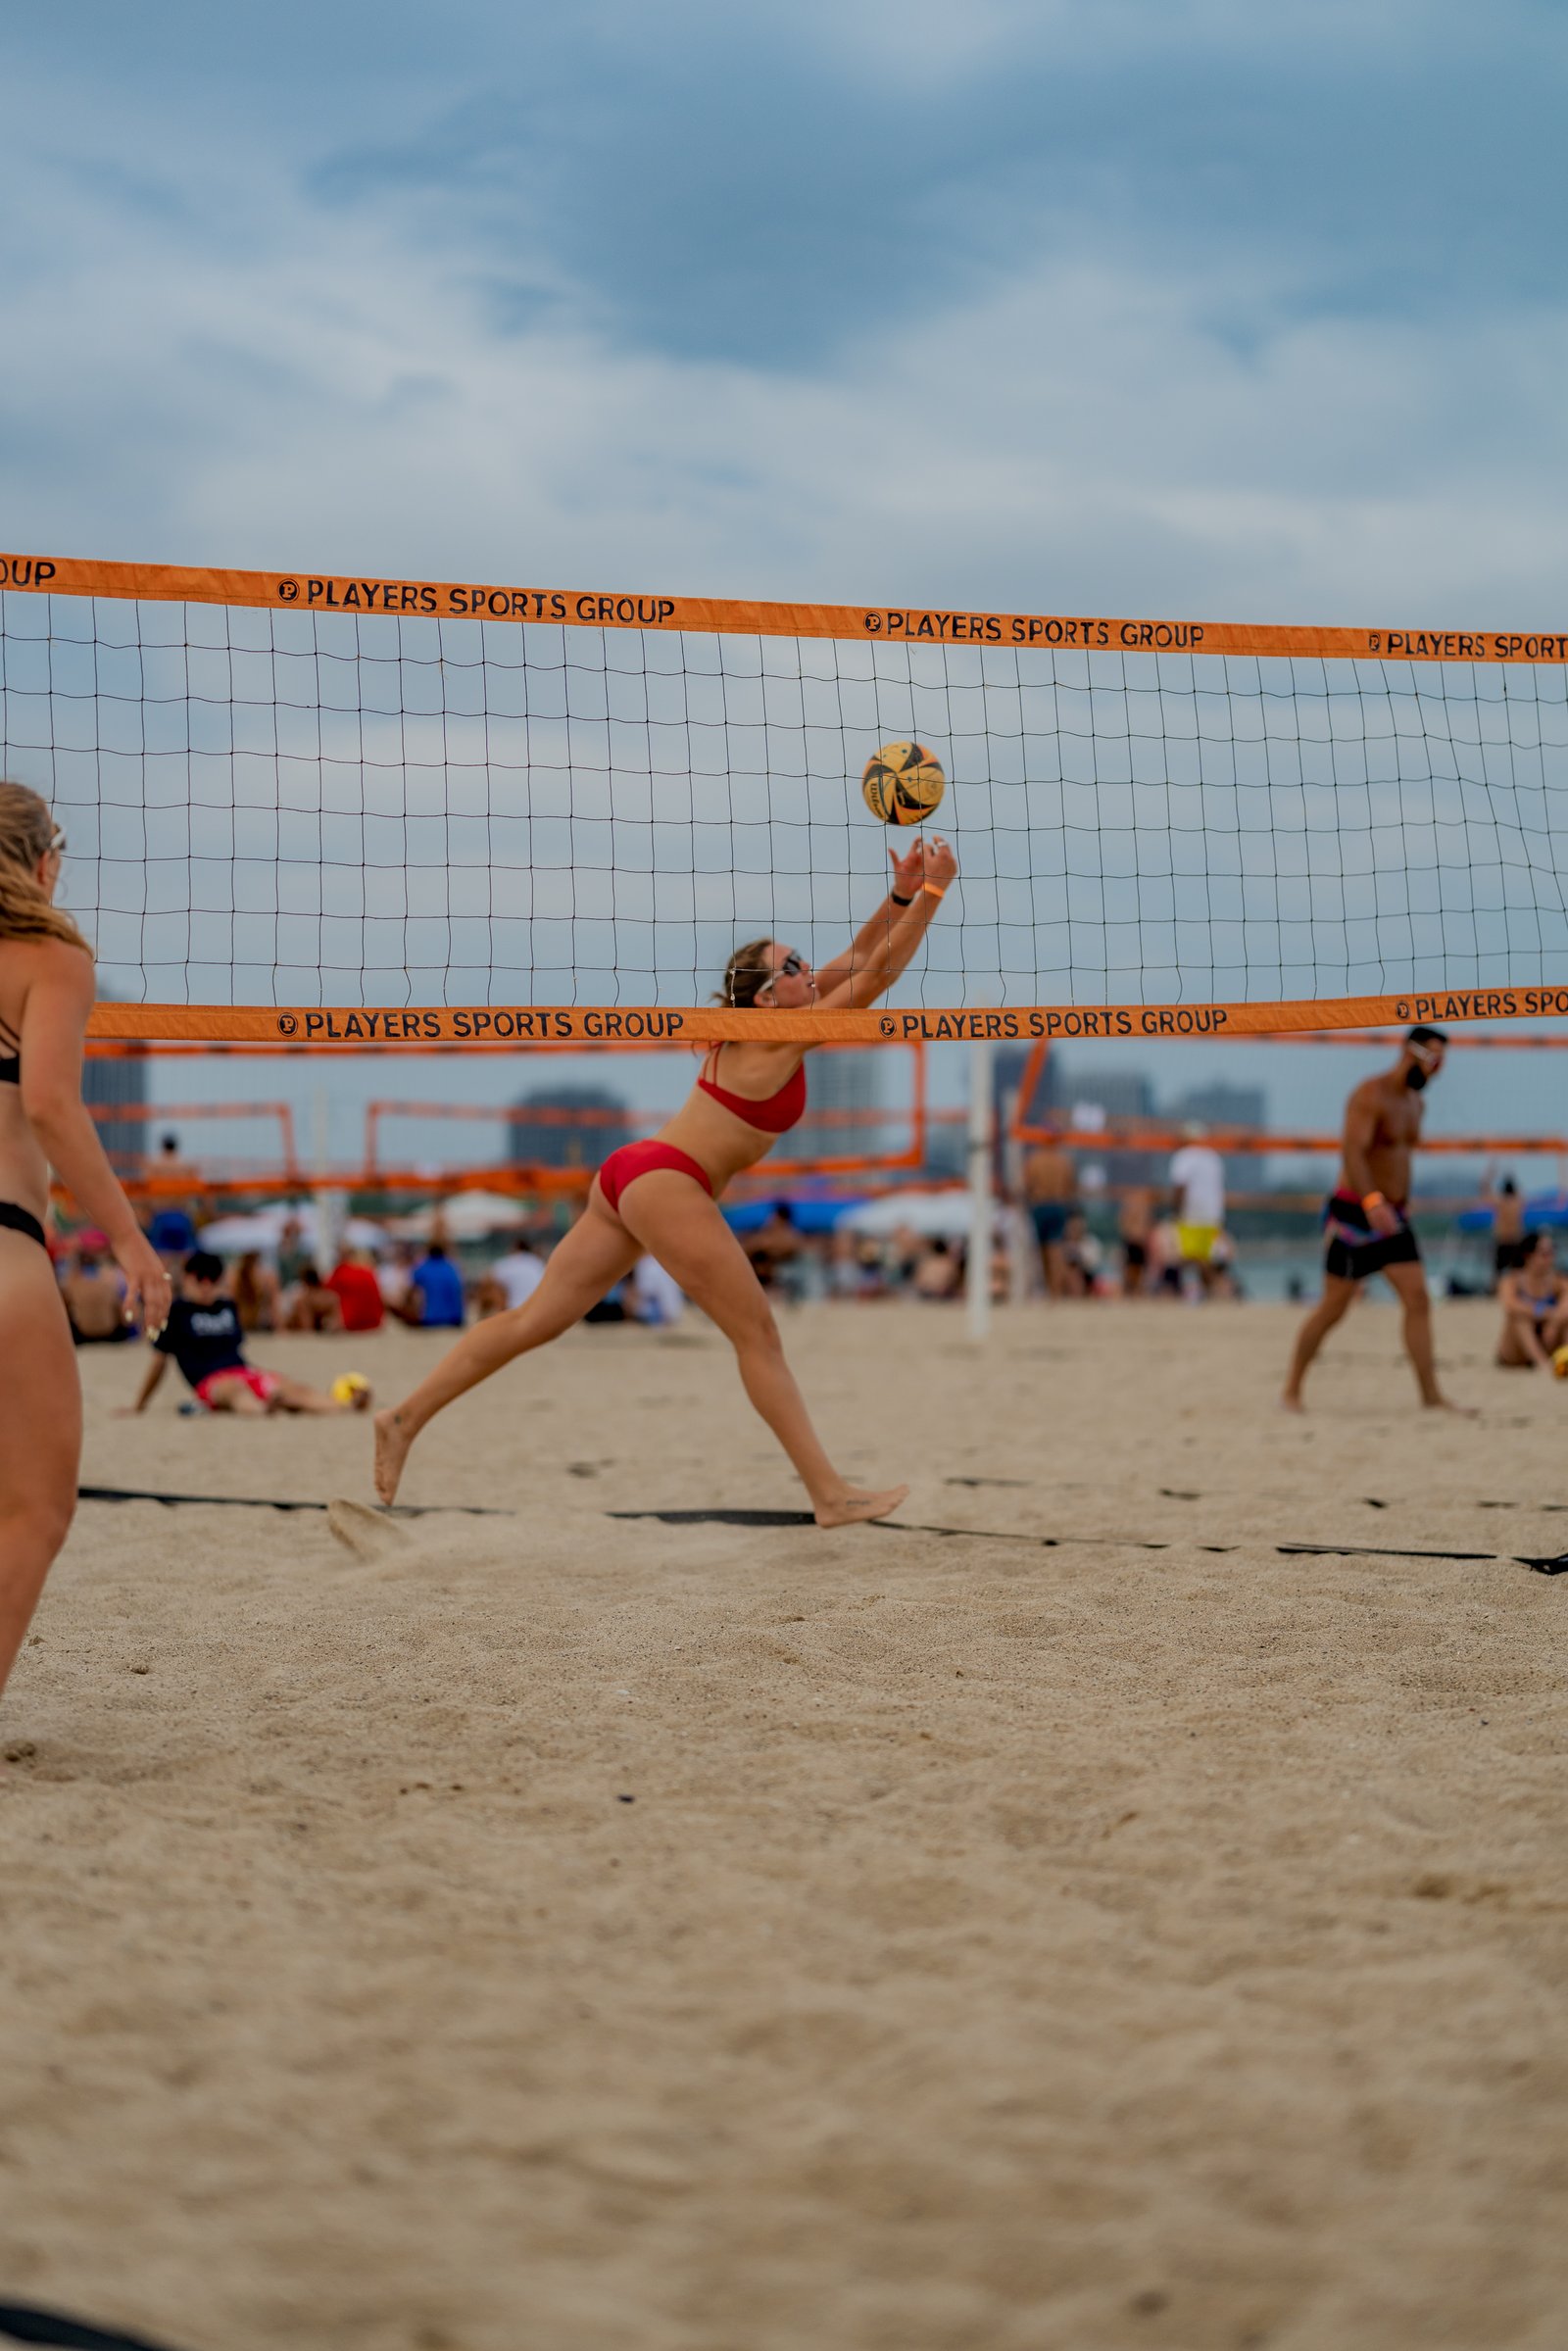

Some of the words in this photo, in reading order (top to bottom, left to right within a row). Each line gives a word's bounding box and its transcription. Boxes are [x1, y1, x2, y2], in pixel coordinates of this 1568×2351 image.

[308, 580, 437, 612] PLAYERS
[449, 588, 566, 618] SPORTS
[576, 596, 674, 623] GROUP
[887, 612, 1002, 641] PLAYERS
[1011, 618, 1108, 645] SPORTS
[1120, 623, 1204, 648] GROUP
[1388, 633, 1485, 658] PLAYERS
[1494, 636, 1568, 659] SPORT
[1415, 993, 1517, 1020] PLAYERS
[306, 1012, 441, 1037] PLAYERS
[453, 1011, 572, 1037] SPORTS
[584, 1012, 683, 1037] GROUP
[902, 1013, 1019, 1038] PLAYERS
[1029, 1010, 1132, 1036] SPORTS
[1142, 1009, 1227, 1034] GROUP
